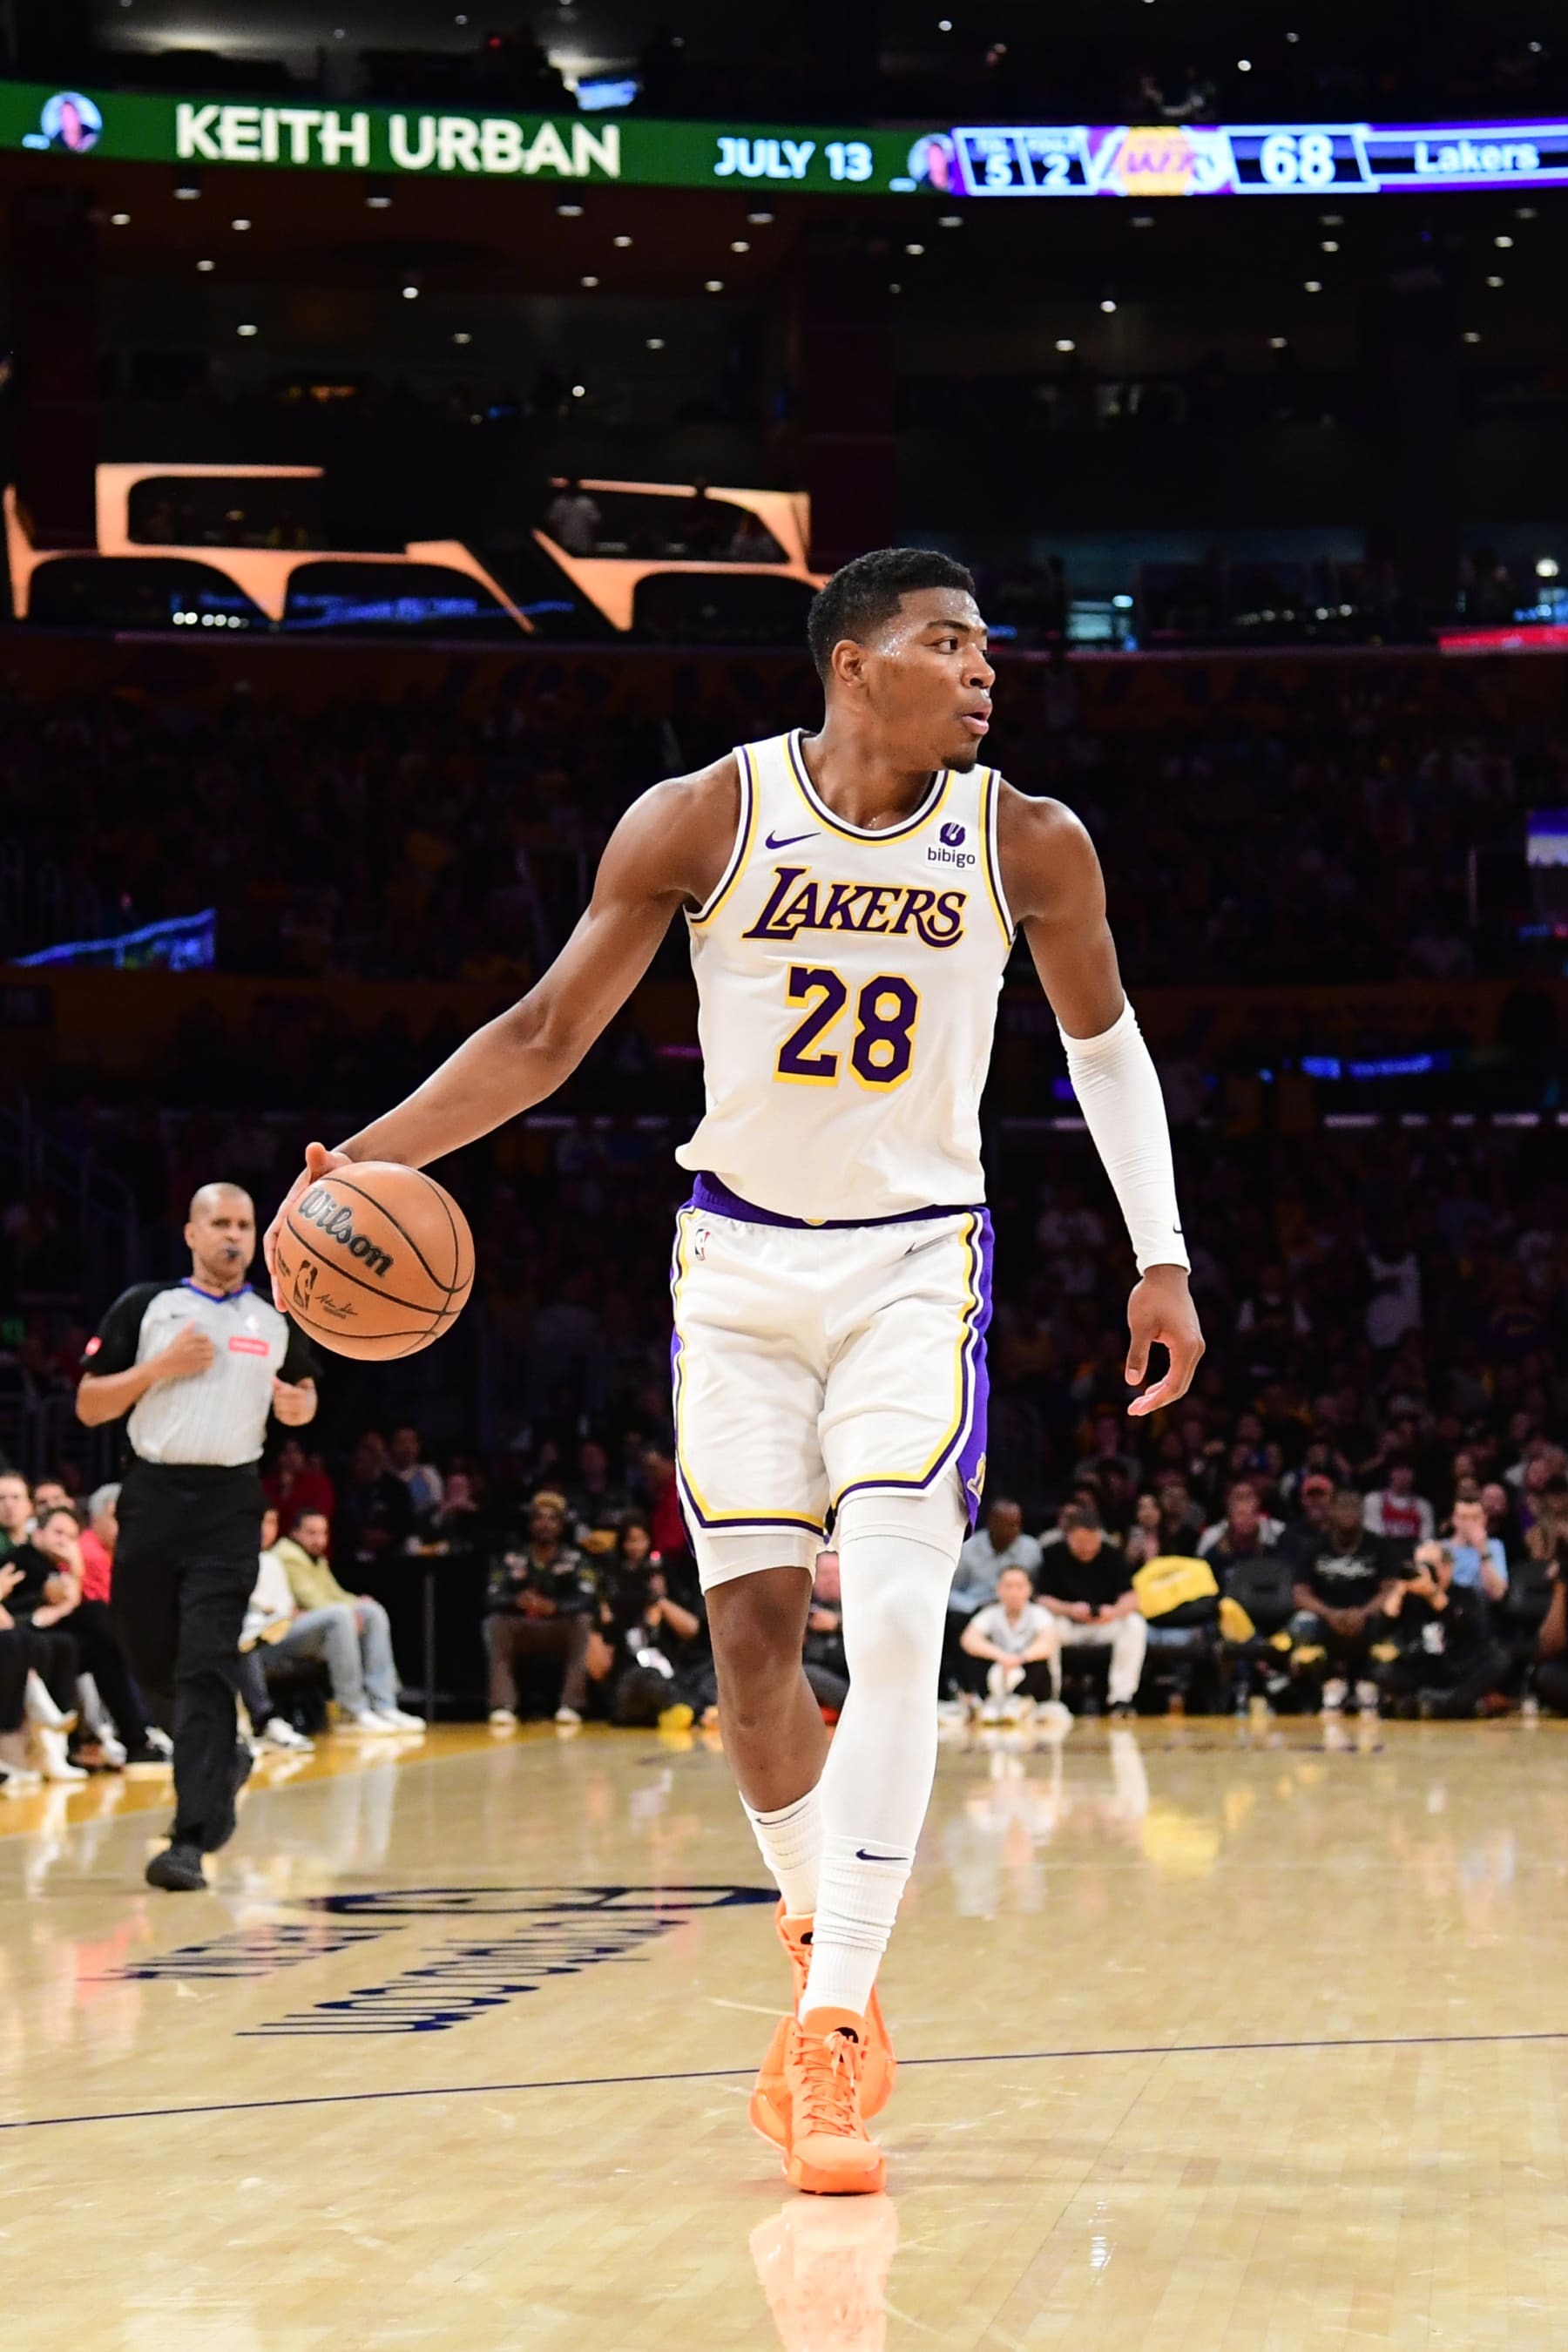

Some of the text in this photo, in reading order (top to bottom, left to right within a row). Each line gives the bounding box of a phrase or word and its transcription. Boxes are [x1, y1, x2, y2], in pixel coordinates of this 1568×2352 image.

[176, 103, 620, 179] KEITH URBAN
[713, 137, 873, 181] JULY 13
[1042, 152, 1071, 186] 2
[1260, 133, 1336, 185] 68
[1414, 138, 1540, 173] Lakers
[927, 846, 976, 868] bibigo
[740, 865, 968, 950] LAKERS
[773, 962, 923, 1094] 28
[297, 1186, 395, 1278] Wilson
[235, 1918, 688, 2037] crypto.com
